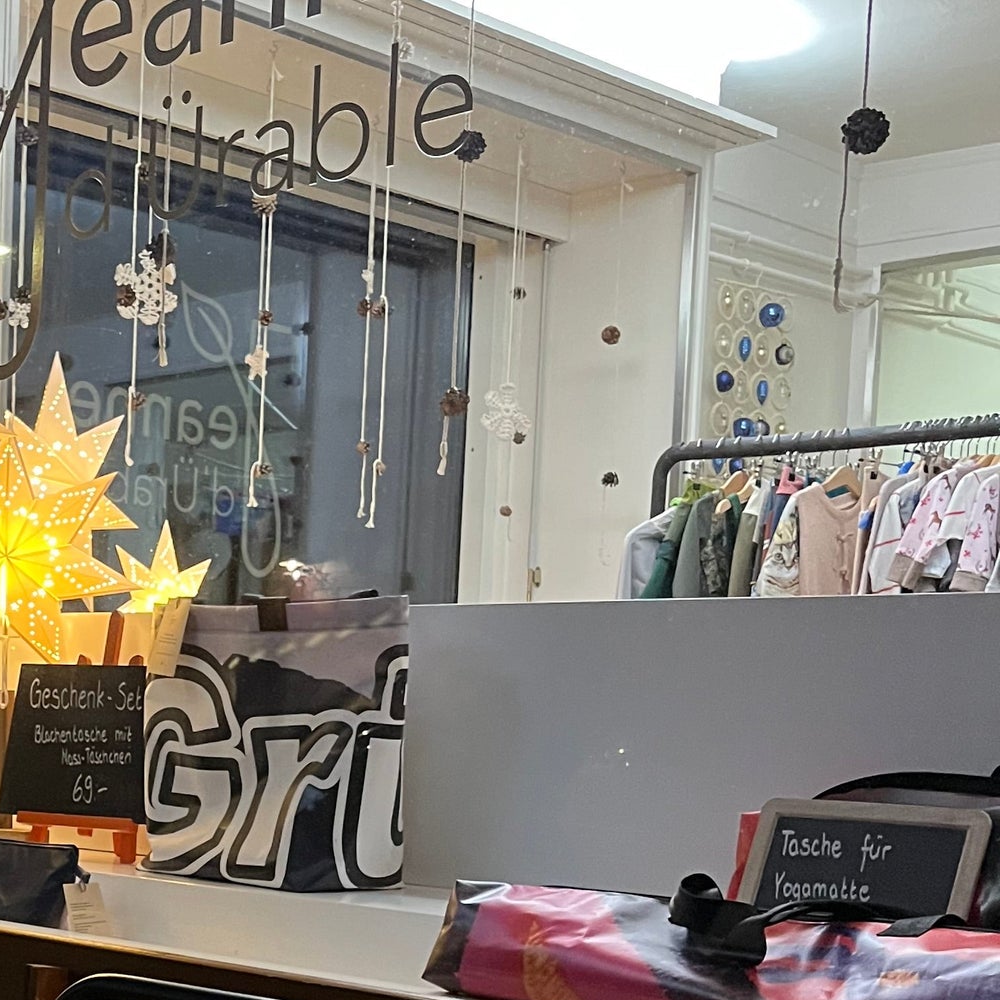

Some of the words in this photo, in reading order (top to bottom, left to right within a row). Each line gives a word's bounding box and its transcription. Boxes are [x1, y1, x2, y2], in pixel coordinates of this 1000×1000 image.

[114, 725, 132, 742] mit
[781, 829, 842, 859] Tasche
[861, 833, 892, 872] für
[775, 871, 871, 903] Yogamatte
